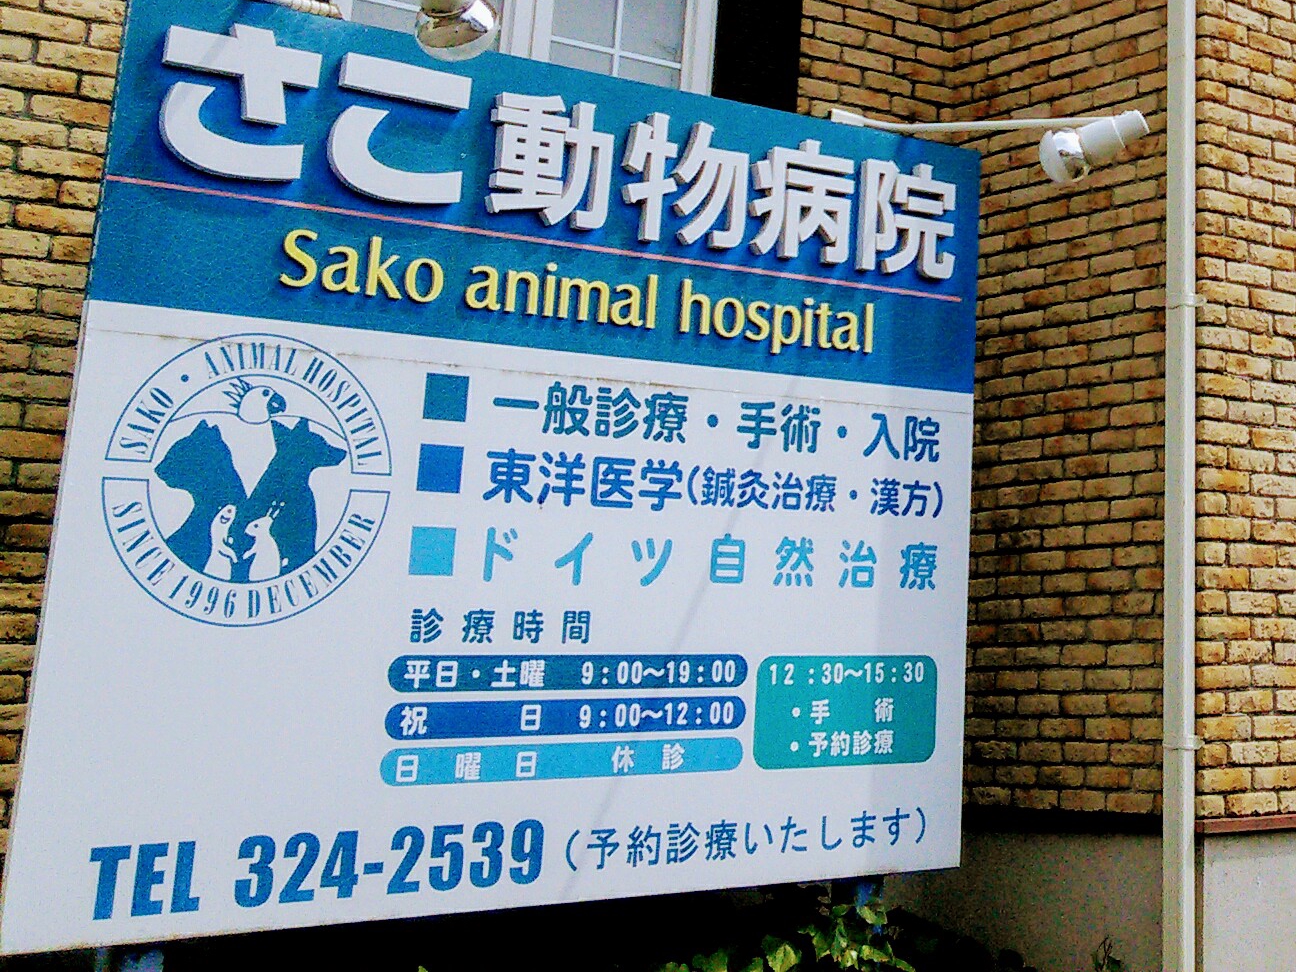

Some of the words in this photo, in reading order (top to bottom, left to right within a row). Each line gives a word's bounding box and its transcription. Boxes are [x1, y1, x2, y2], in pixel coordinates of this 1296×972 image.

[158, 23, 958, 279] さこ動物病院
[279, 228, 446, 305] Sako
[466, 262, 658, 330] animal
[679, 291, 875, 355] hospital
[119, 386, 175, 455] SAKO
[203, 341, 299, 380] ANIMAL
[302, 356, 382, 467] HOSPITAL
[492, 380, 941, 463] 一般診療・手術・入院
[111, 500, 176, 586] SINCE
[168, 574, 238, 619] 1996
[247, 512, 376, 618] DECEMBER
[402, 658, 547, 689] 平日・土曜
[409, 608, 593, 645] 診療時間
[90, 839, 200, 921] TEL
[233, 818, 546, 908] 324-2539
